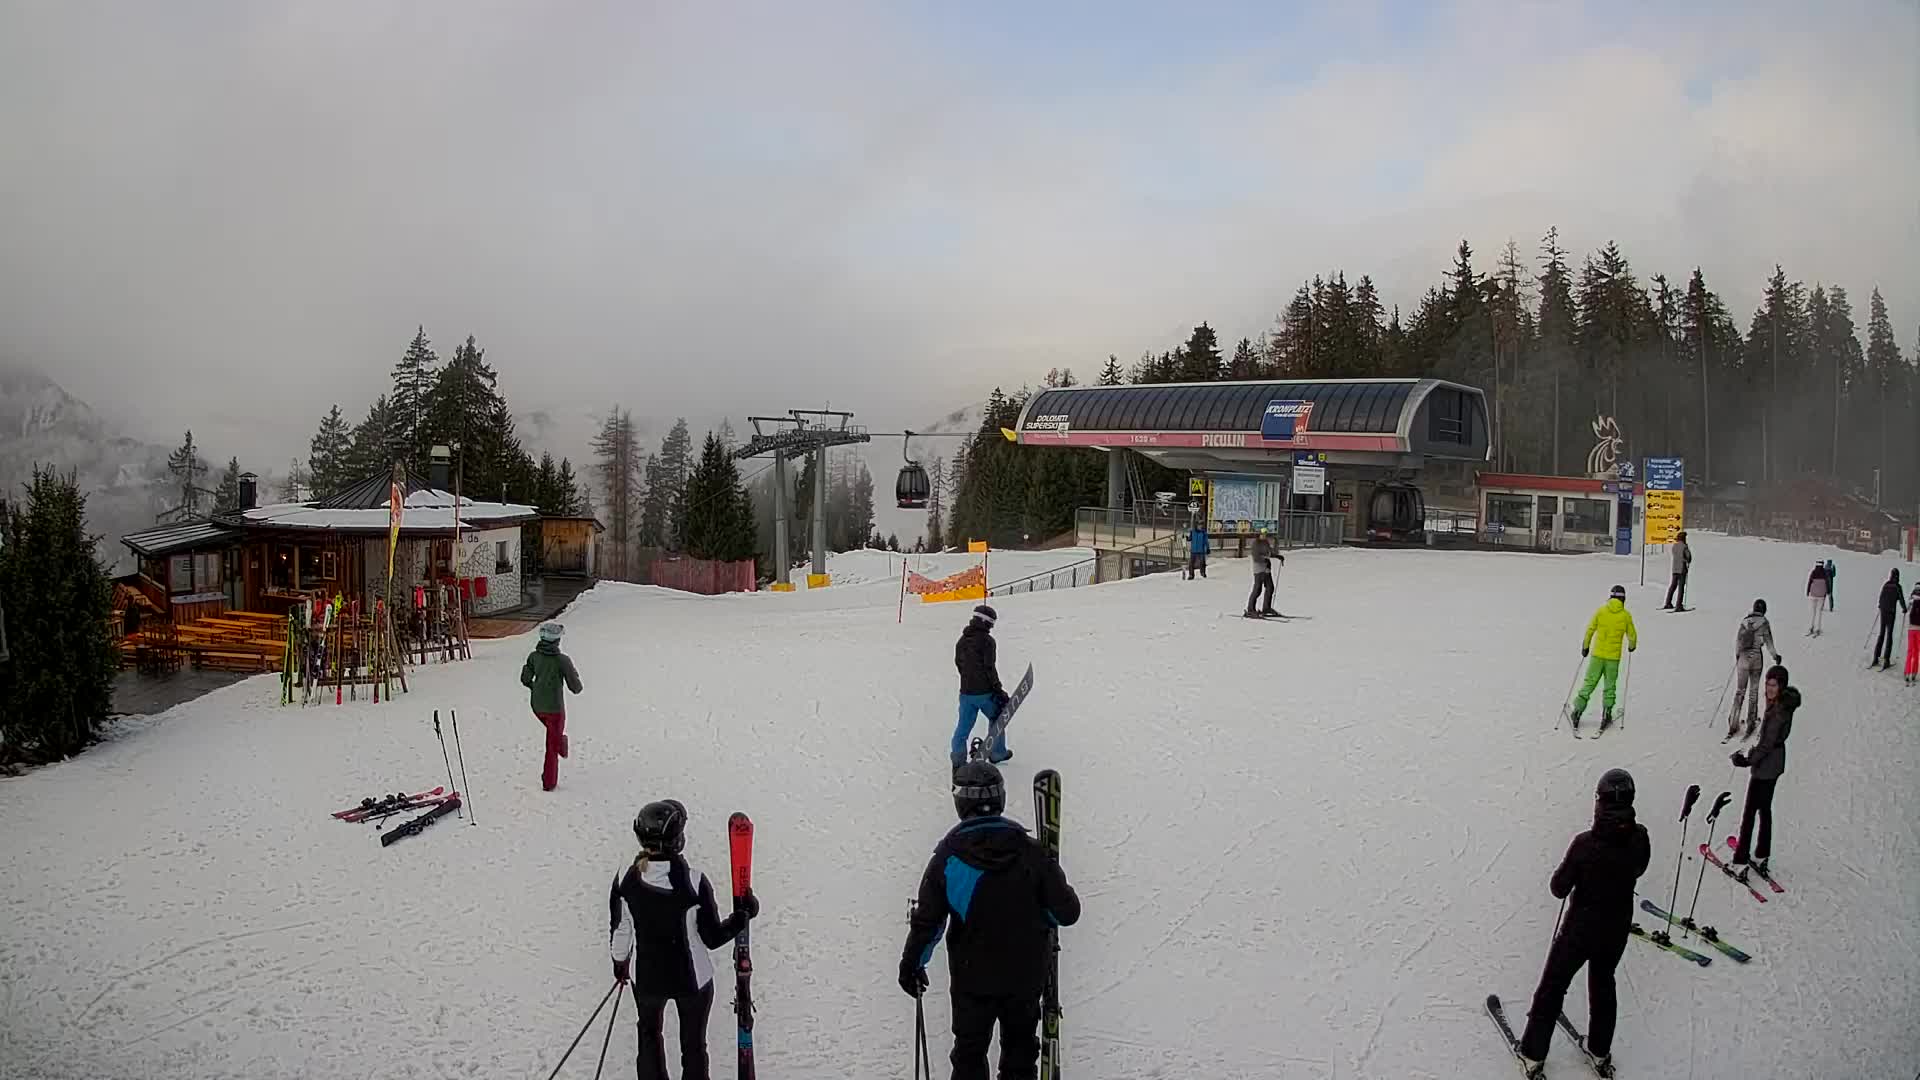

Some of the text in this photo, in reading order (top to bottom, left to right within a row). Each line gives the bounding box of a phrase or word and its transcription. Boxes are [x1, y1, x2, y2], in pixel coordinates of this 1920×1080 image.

[1266, 405, 1311, 413] KRONPLATZ
[1036, 414, 1069, 422] DOLOMITI
[1025, 421, 1059, 430] SUPERSKI
[1201, 434, 1245, 447] PICULIN
